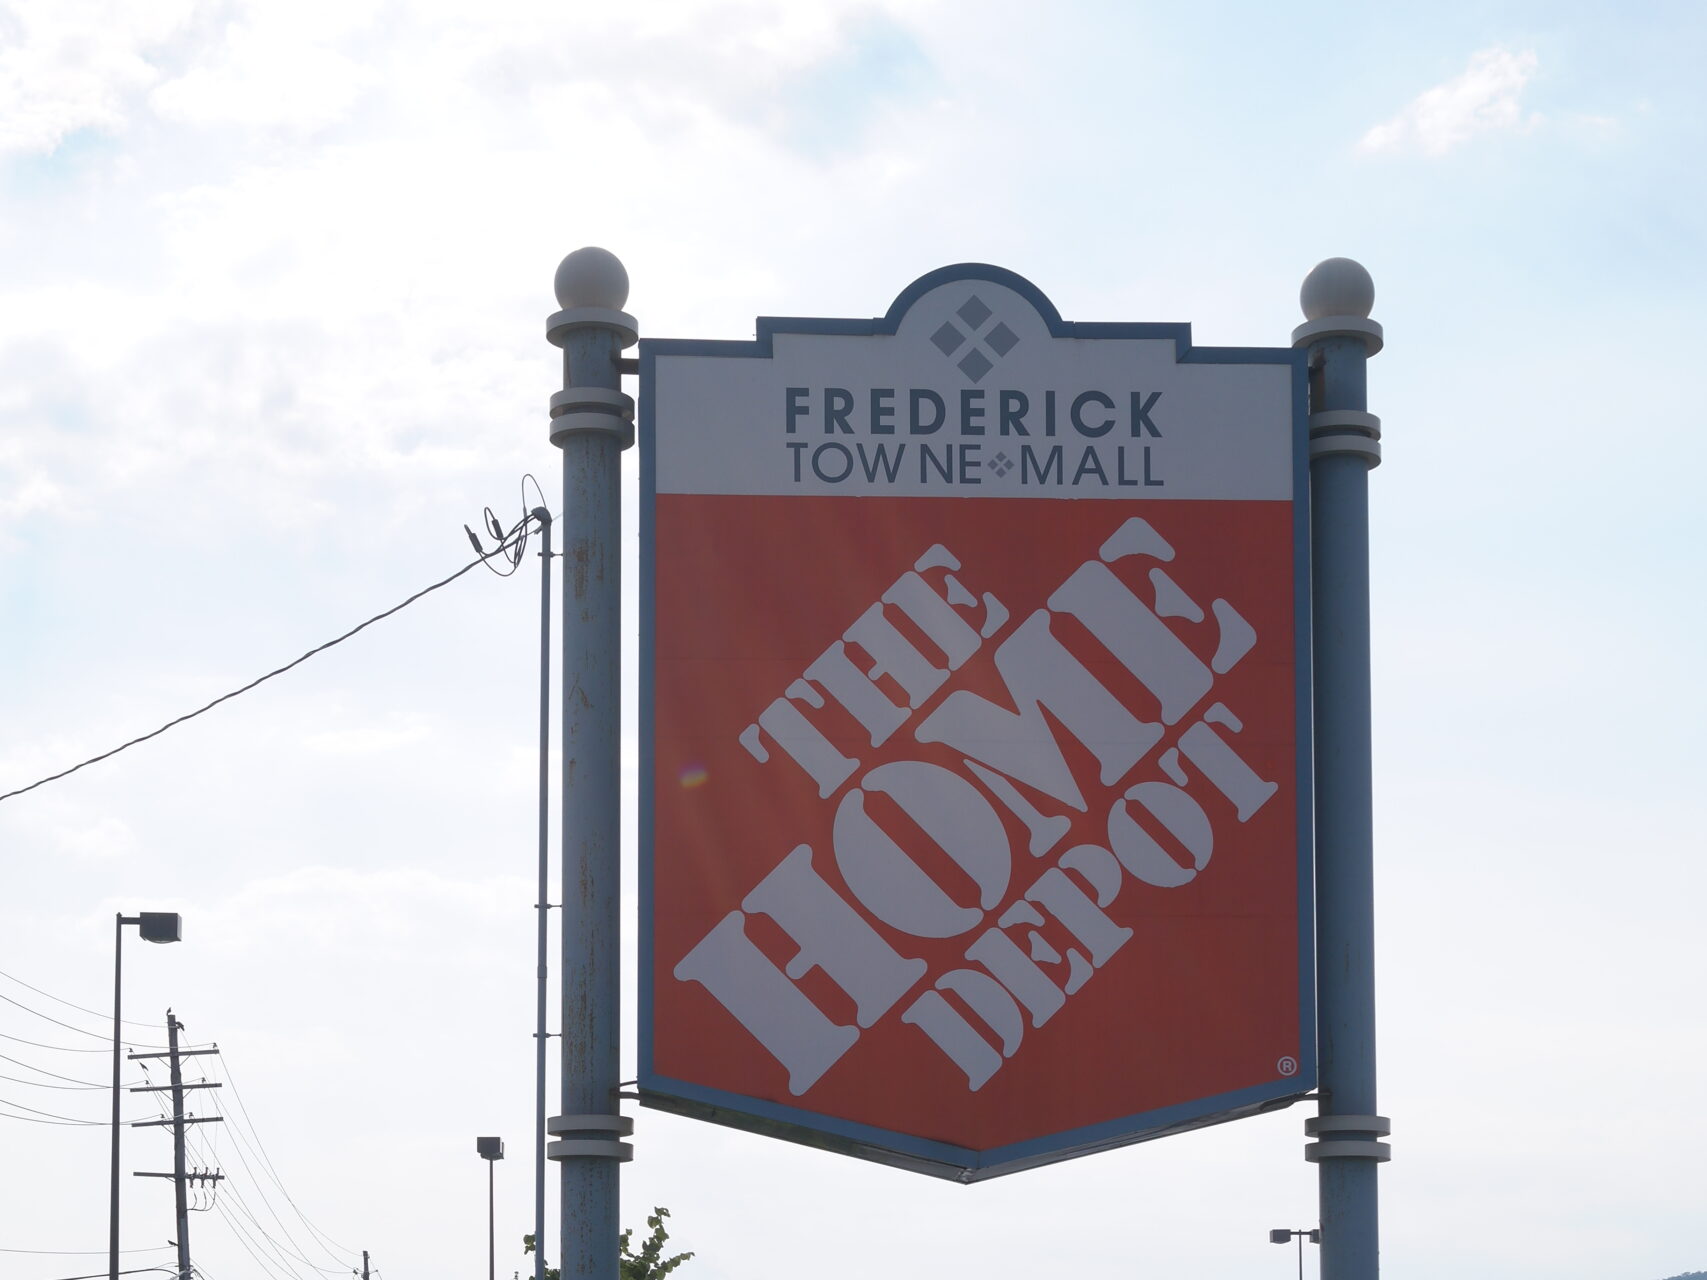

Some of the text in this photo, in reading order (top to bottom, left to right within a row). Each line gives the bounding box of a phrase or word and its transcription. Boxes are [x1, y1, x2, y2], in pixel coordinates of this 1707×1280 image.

[785, 387, 1163, 438] FREDERICK
[786, 442, 1164, 486] TOWNE MALL
[739, 543, 1010, 799] THE
[673, 516, 1257, 1096] HOME
[901, 701, 1279, 1092] DEPOT
